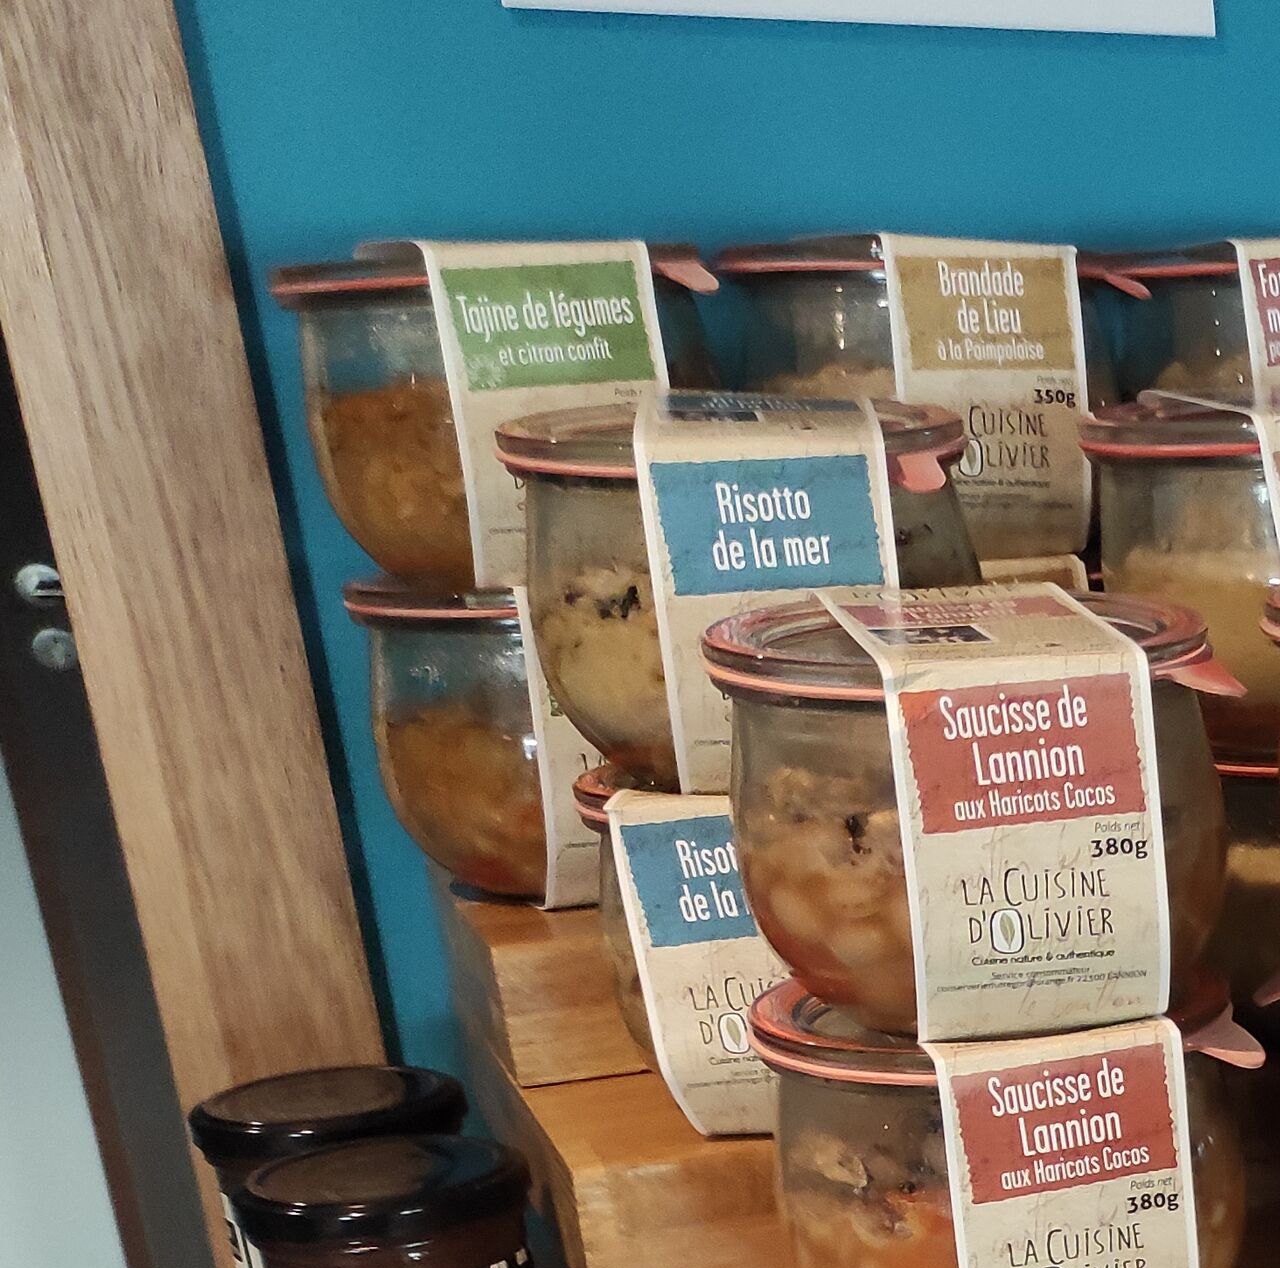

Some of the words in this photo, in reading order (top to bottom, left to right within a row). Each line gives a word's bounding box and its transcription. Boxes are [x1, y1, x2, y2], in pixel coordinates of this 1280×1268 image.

[937, 259, 1025, 297] Brandade
[456, 294, 519, 343] Tajine
[522, 290, 549, 331] de
[550, 290, 635, 337] légumes
[957, 298, 980, 335] de
[983, 299, 1021, 335] Lieu
[499, 343, 516, 366] et
[518, 343, 565, 365] citron
[567, 336, 613, 362] confit
[937, 339, 947, 361] à
[948, 338, 962, 361] la
[965, 338, 1045, 365] Paimpolaise
[1033, 388, 1076, 408] 350g
[714, 481, 812, 525] Risotto
[711, 530, 746, 572] de
[749, 528, 778, 569] la
[783, 533, 831, 568] mer
[939, 692, 1051, 740] Saucisse
[1056, 685, 1089, 730] de
[972, 737, 1086, 786] Lannion
[954, 799, 987, 821] aux
[987, 789, 1061, 817] Haricots
[1063, 781, 1116, 809] Cocos
[1094, 820, 1121, 833] Poids
[674, 839, 740, 880] Risot
[1090, 838, 1148, 859] 380g
[678, 884, 711, 924] de
[710, 880, 739, 920] la
[961, 876, 995, 906] LA
[1003, 867, 1111, 906] CUISINE
[971, 955, 1008, 967] Cuisine
[1010, 954, 1043, 965] nature
[1055, 949, 1116, 961] authentique
[688, 985, 719, 1011] LA
[987, 1069, 1092, 1118] Saucisse
[1096, 1057, 1125, 1099] de
[1018, 1108, 1123, 1157] Lannion
[1000, 1170, 1032, 1191] aux
[1033, 1154, 1101, 1186] Haricots
[1102, 1146, 1150, 1172] Cocos
[1126, 1193, 1179, 1214] 380g
[1007, 1239, 1039, 1267] LA
[1046, 1222, 1145, 1265] CUISINE
